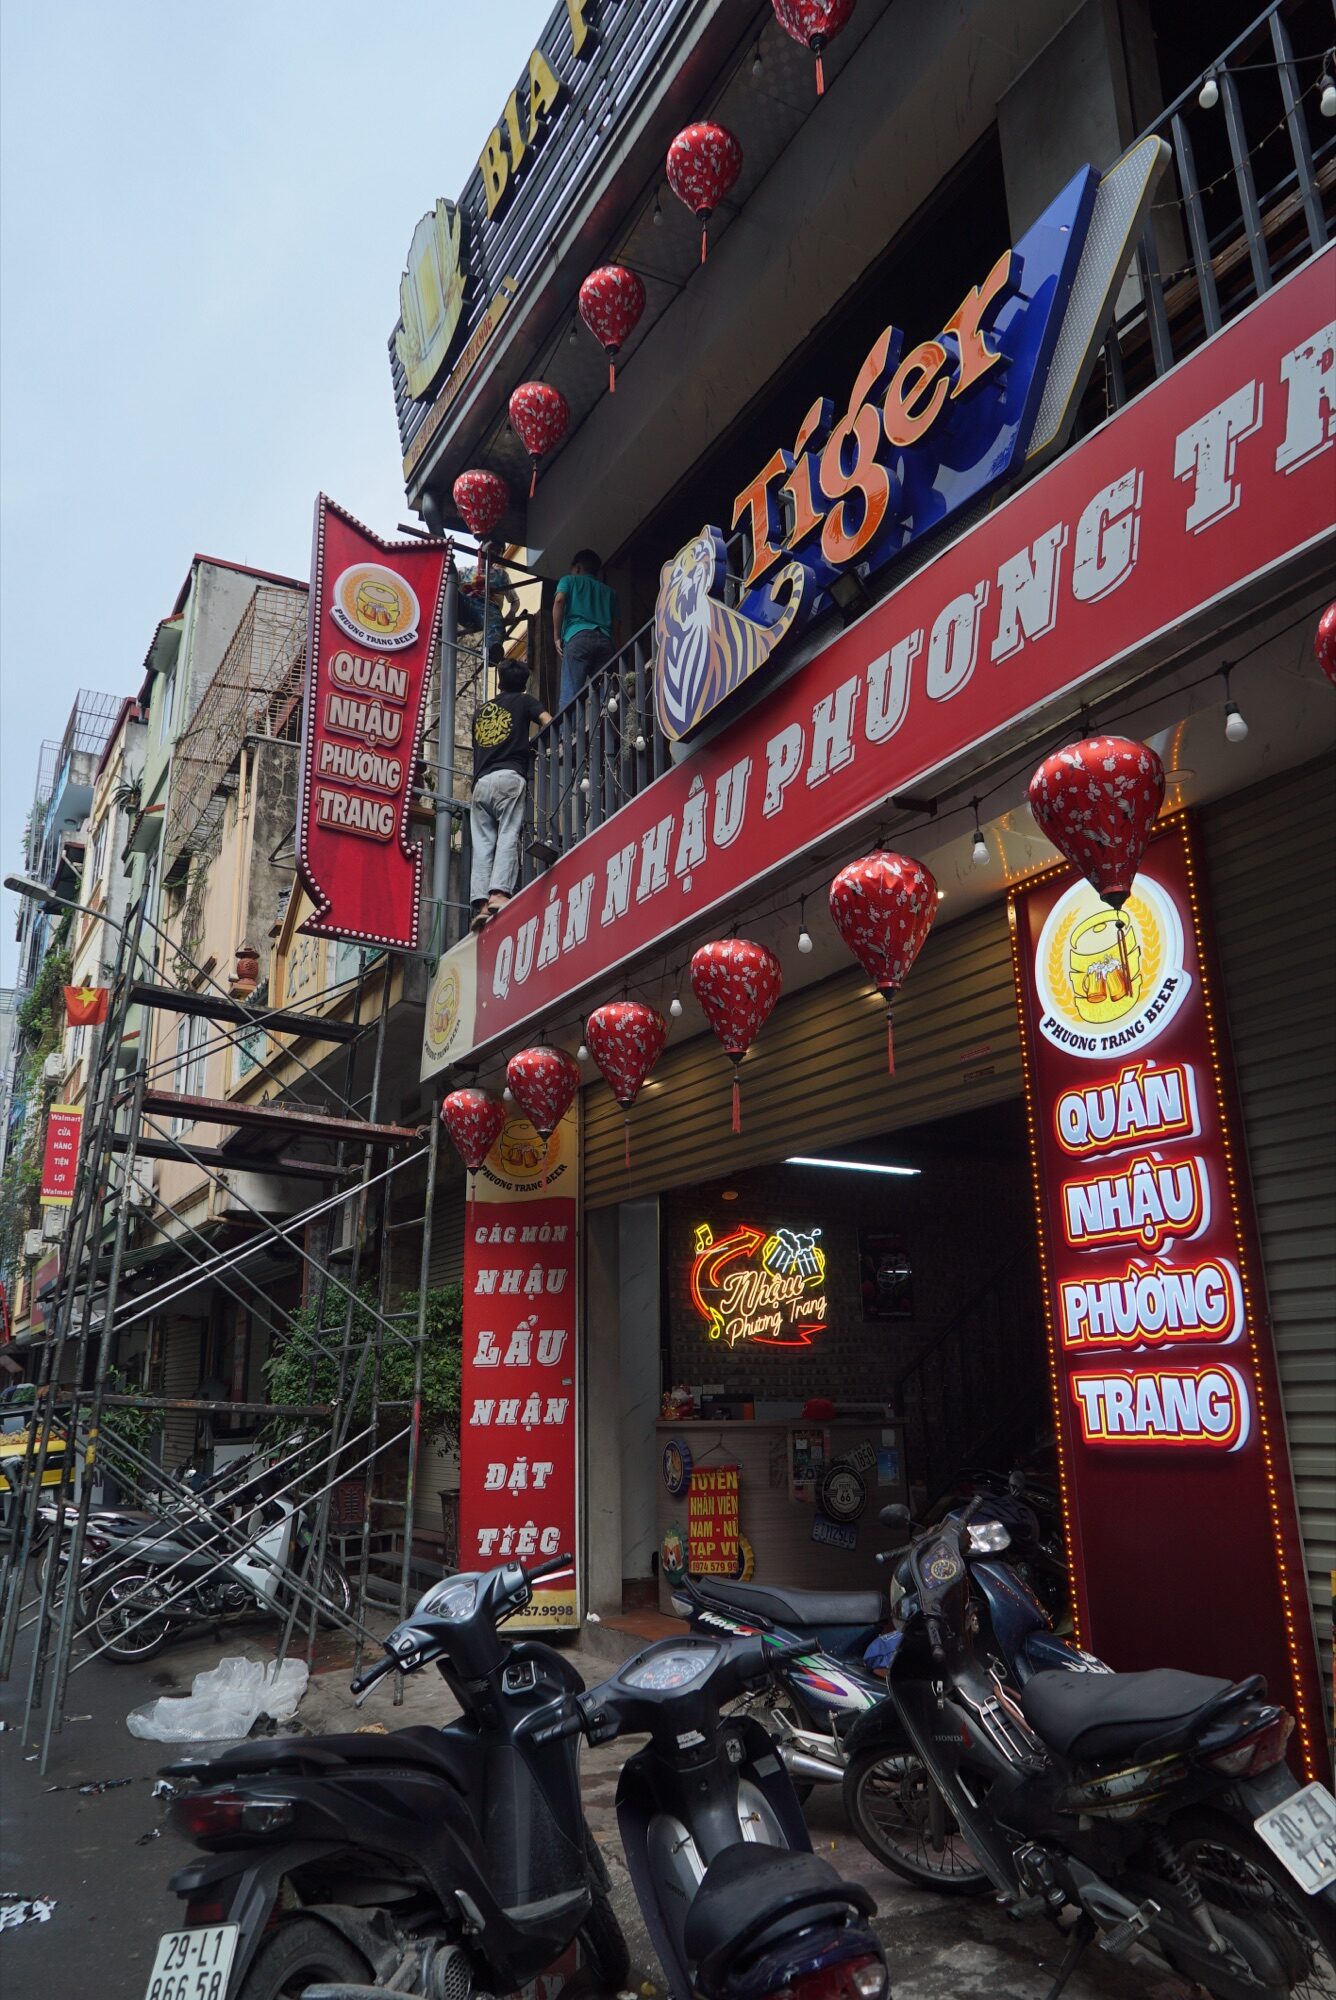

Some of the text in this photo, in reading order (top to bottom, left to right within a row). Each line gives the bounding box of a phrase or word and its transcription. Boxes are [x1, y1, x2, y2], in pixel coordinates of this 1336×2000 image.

[479, 49, 561, 220] BIA
[731, 248, 1013, 587] Tiger
[393, 631, 416, 645] BEER
[333, 652, 407, 698] QUÁN
[329, 699, 401, 741] NHẬU
[320, 792, 394, 835] TRANG
[492, 873, 596, 1001] QUÁN
[601, 756, 753, 928] NHẬU
[1100, 1019, 1145, 1051] TRANG
[1144, 977, 1179, 1024] BEER
[1059, 1070, 1183, 1144] QUÁN
[1066, 1161, 1195, 1237] NHẬU
[474, 1221, 568, 1244] CÁC MÓN
[474, 1263, 568, 1300] NHẬU
[720, 1270, 805, 1317] Nhậu
[1064, 1267, 1226, 1338] PHƯƠNG
[786, 1296, 828, 1323] Trang
[469, 1391, 569, 1432] NHẬN
[1077, 1373, 1232, 1433] TRANG
[484, 1456, 553, 1497] ĐẶT
[840, 1492, 851, 1502] 66
[690, 1520, 713, 1538] NAM
[690, 1541, 716, 1559] TẠP
[163, 1930, 224, 1972] 29-L1
